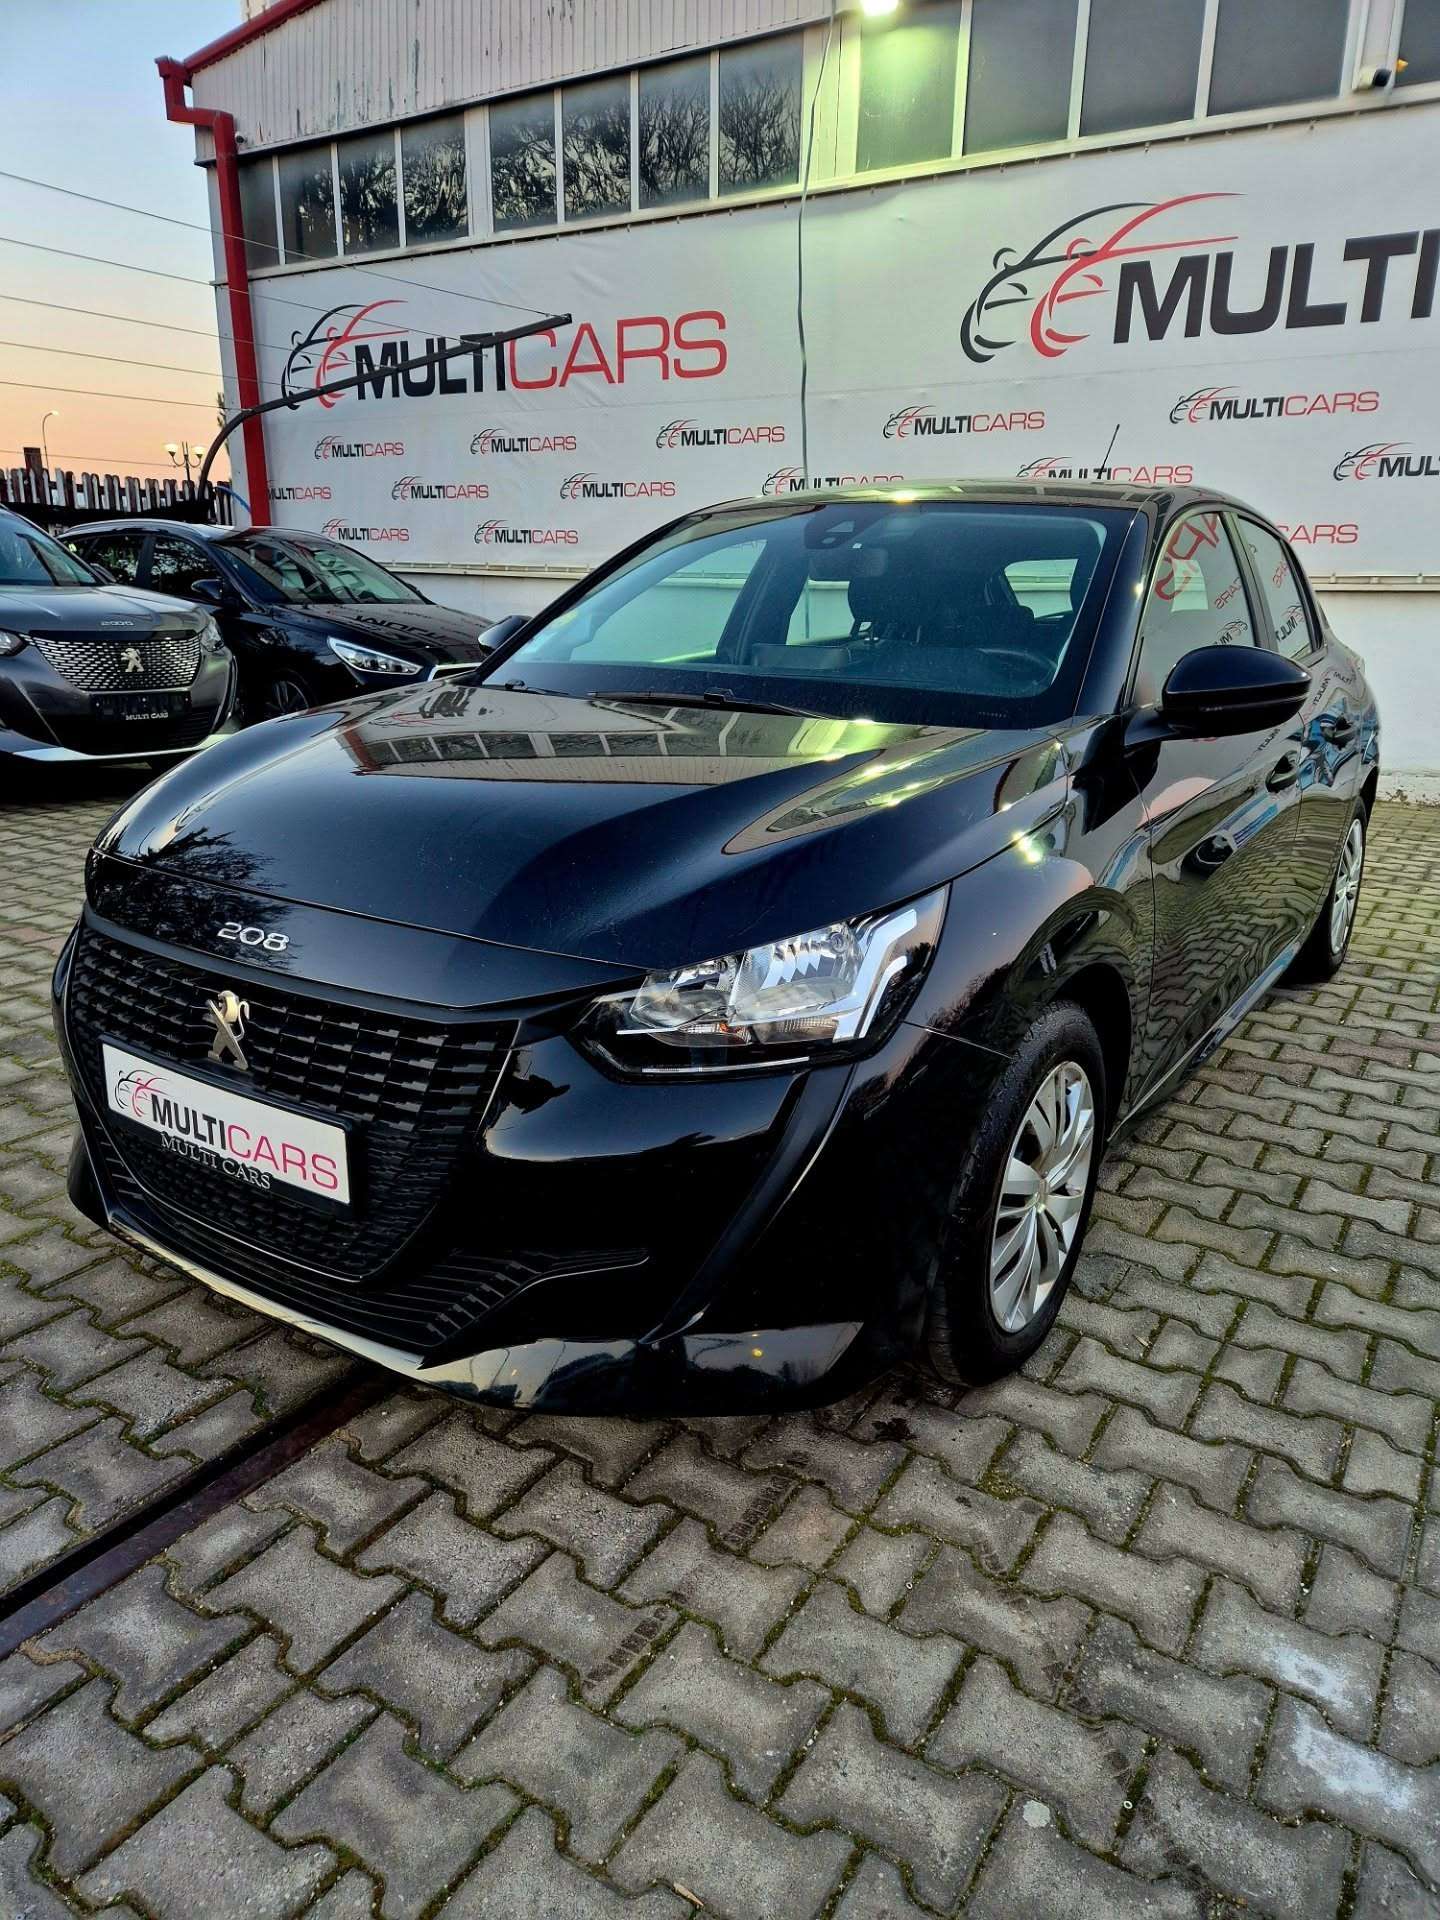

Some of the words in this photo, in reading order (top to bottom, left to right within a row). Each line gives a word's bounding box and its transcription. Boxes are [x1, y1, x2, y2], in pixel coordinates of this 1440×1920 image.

[354, 309, 728, 402] MULTICARS
[1209, 391, 1379, 421] MULTICARS
[913, 411, 1045, 437] MULTICARS
[491, 435, 577, 453] MULTICARS
[681, 425, 785, 447] MULTICARS
[331, 442, 405, 458] MULTICARS
[1378, 455, 1440, 478] MUL
[410, 484, 489, 500] MULTICARS
[582, 481, 676, 498] MULTICARS
[338, 527, 410, 542] MULTICARS
[494, 529, 579, 545] MULTICARS
[217, 921, 289, 952] 208
[150, 1093, 339, 1190] MULTICARS
[159, 1131, 217, 1169] MULTI
[222, 1160, 271, 1191] CARS
